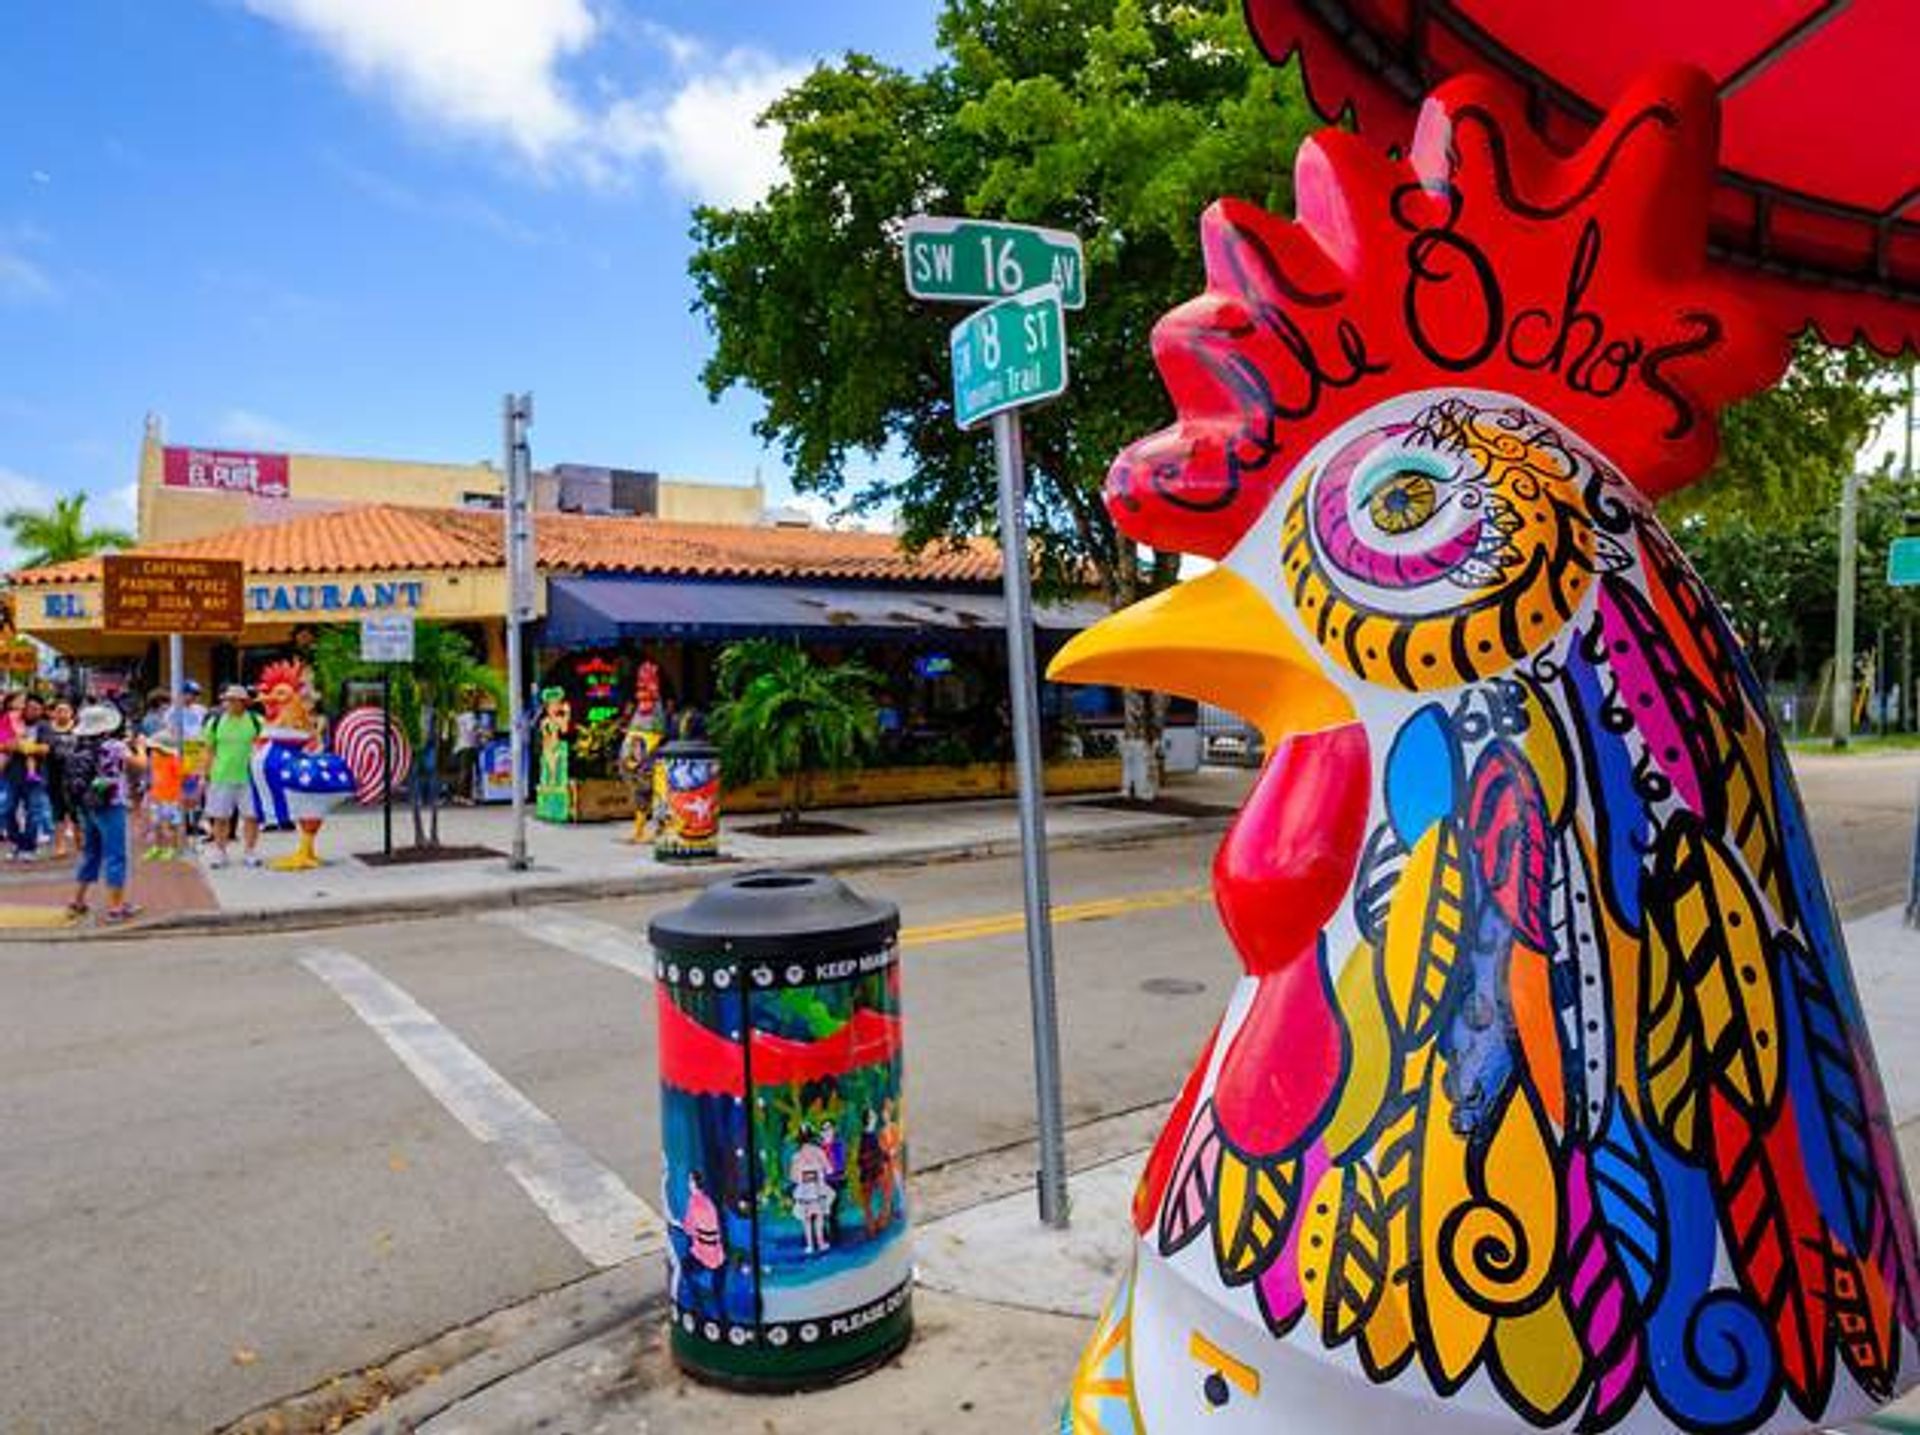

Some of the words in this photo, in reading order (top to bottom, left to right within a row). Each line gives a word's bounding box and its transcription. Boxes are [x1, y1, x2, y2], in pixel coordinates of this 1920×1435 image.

[914, 244, 953, 283] SW
[981, 235, 1023, 292] 16
[1051, 253, 1075, 291] AV
[980, 312, 1001, 371] 8
[1023, 310, 1049, 353] ST
[1004, 360, 1042, 398] Trail
[46, 593, 87, 618] EL
[815, 958, 858, 980] KEEP
[831, 1301, 886, 1335] PLEASE
